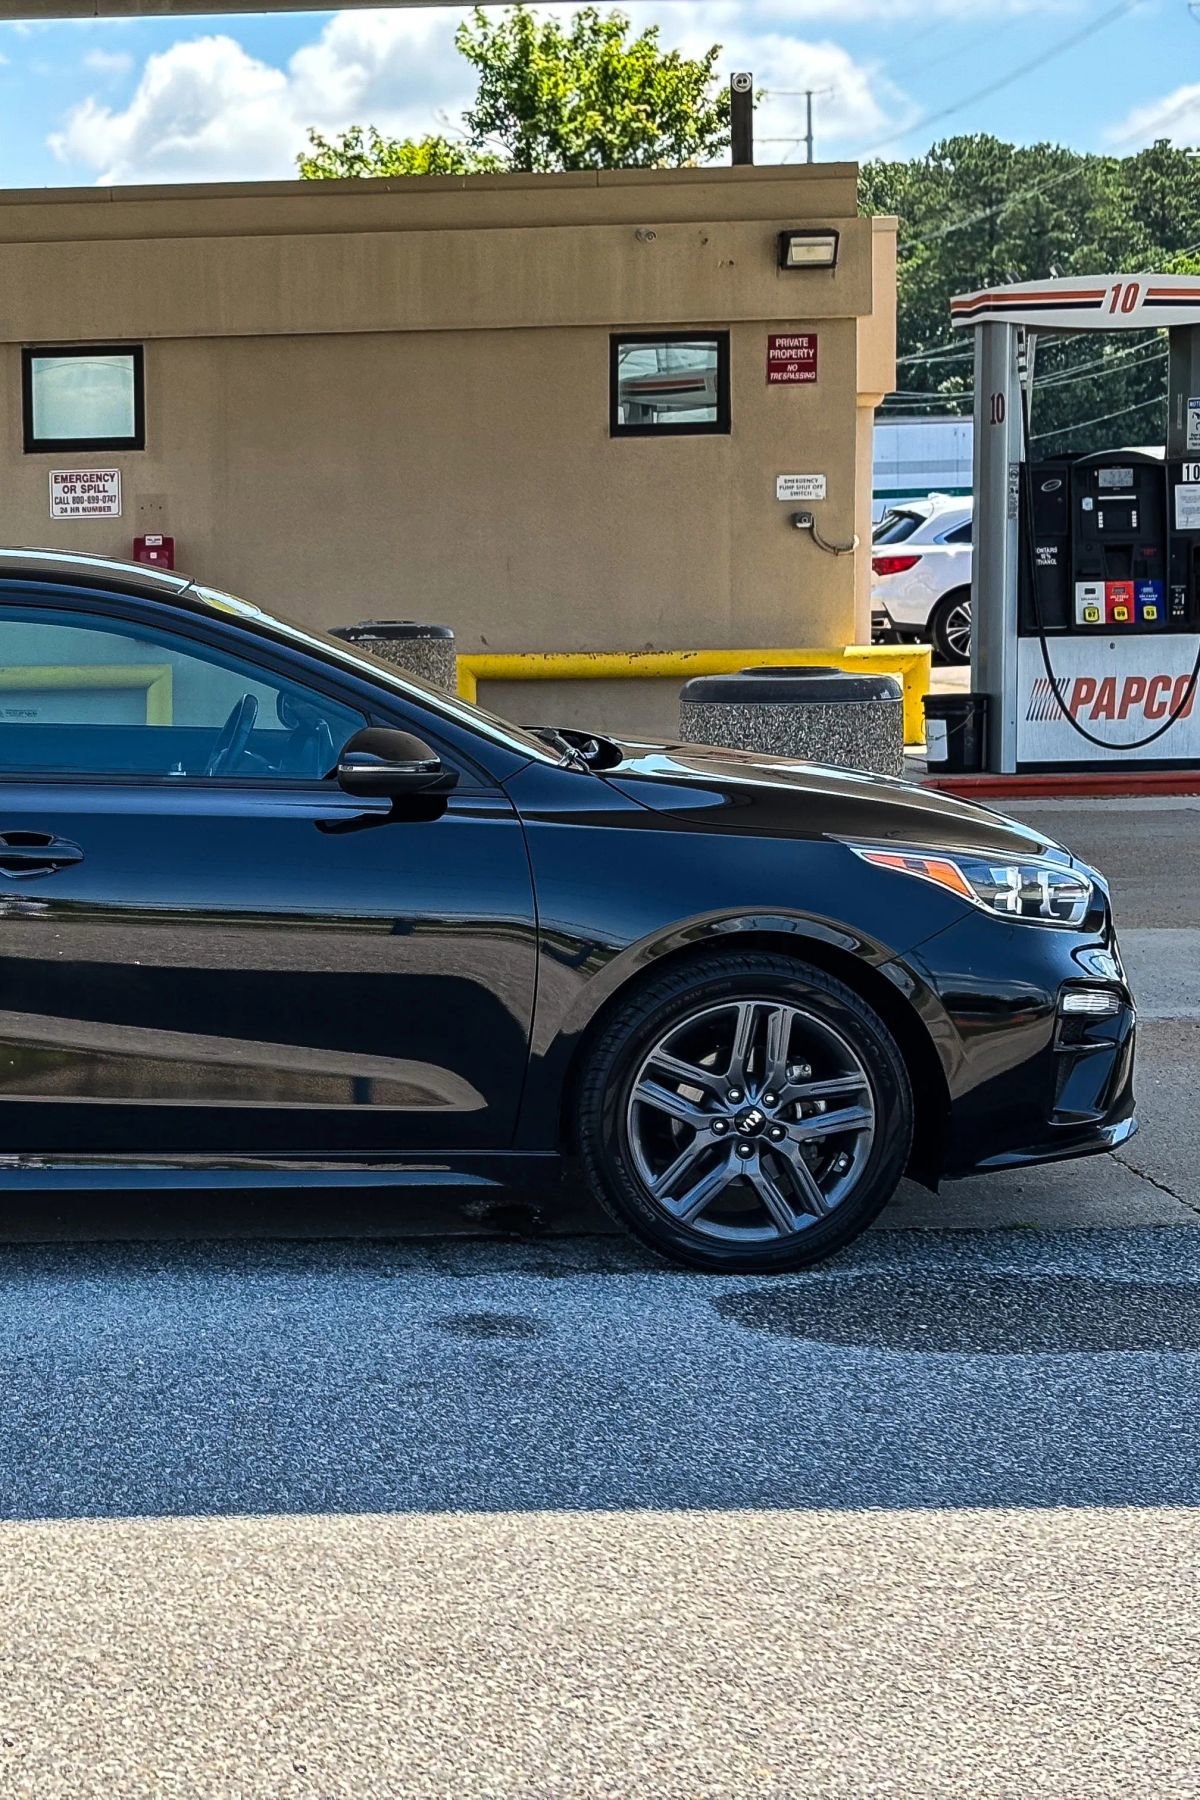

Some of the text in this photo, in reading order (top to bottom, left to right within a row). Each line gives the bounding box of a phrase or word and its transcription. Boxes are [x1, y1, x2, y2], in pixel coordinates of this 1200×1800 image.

[1109, 283, 1140, 314] 10
[776, 338, 809, 347] PRIVATE
[770, 349, 814, 359] PROPERTY
[787, 364, 798, 372] NO
[770, 372, 816, 380] TRESPASSING
[991, 392, 1005, 425] 10
[1185, 464, 1200, 481] 10
[53, 473, 116, 484] EMERGENCY
[62, 484, 108, 494] OR SPILL
[54, 496, 70, 505] CALL
[1069, 674, 1198, 720] PAPCO
[739, 1110, 762, 1132] KIA
